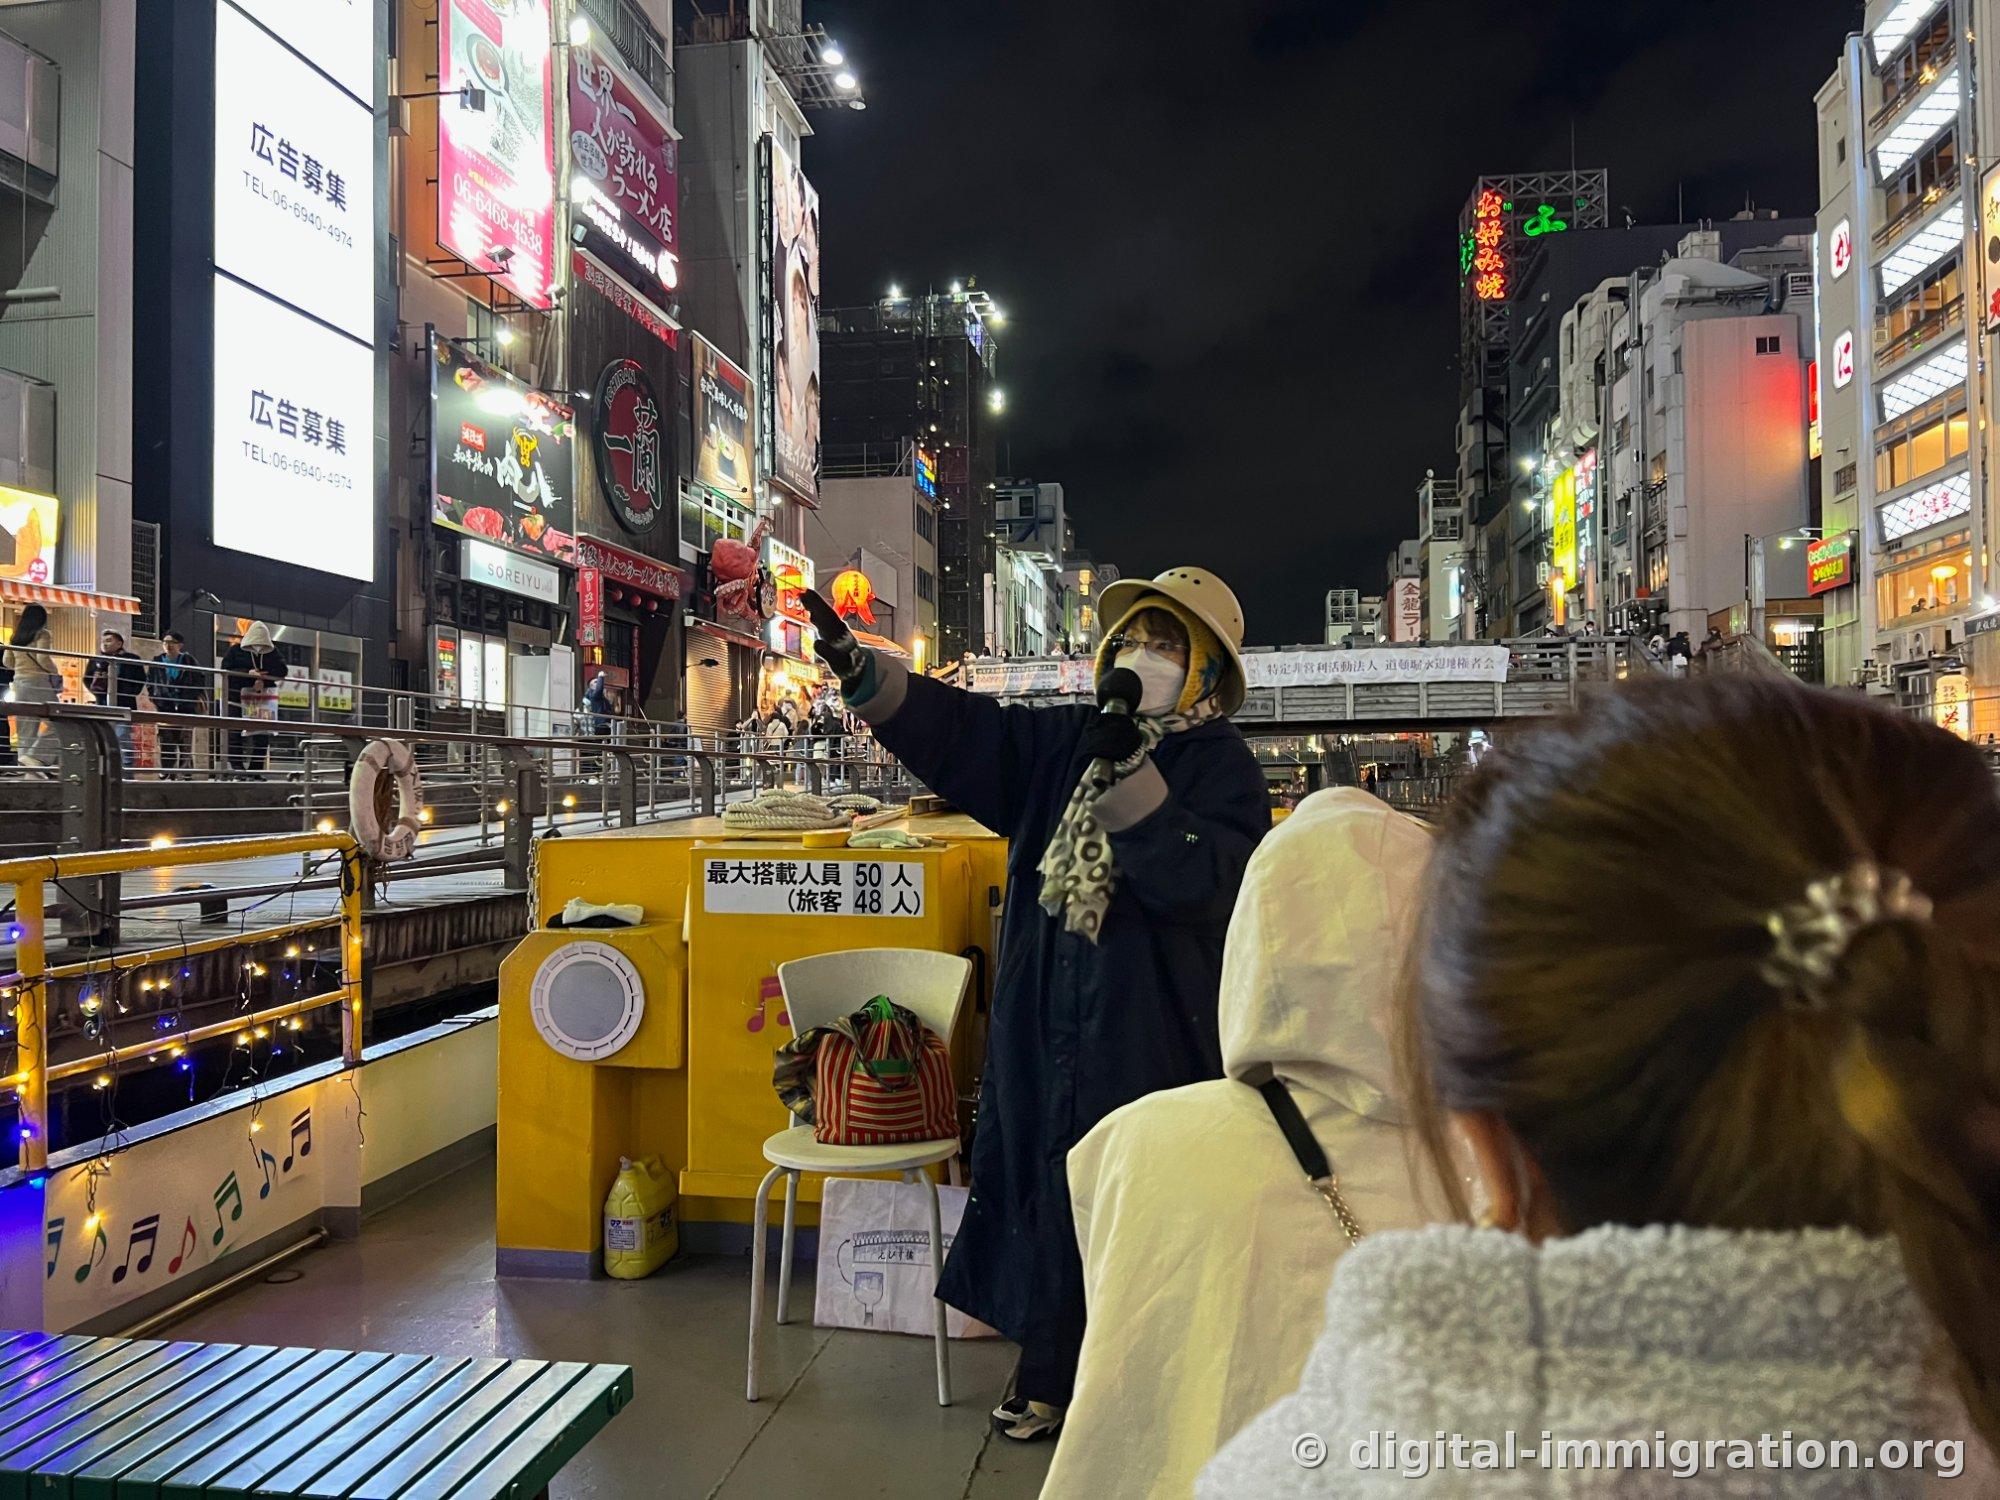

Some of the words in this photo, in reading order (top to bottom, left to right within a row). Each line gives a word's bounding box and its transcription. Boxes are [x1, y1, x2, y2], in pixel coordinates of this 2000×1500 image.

[250, 121, 348, 212] 広告募集
[590, 107, 659, 195] 人が訪れる
[453, 173, 543, 256] 06-6468-4538
[612, 163, 673, 243] ラーメン店
[1474, 190, 1505, 300] お好み焼
[249, 389, 346, 456] 広告募集
[603, 396, 662, 510] 一蘭
[487, 563, 542, 590] SOREIYU
[1401, 582, 1421, 641] 金龍ラー
[1267, 660, 1378, 676] 特定非営利活動法人
[707, 861, 842, 886] 最大搭載人員
[855, 863, 882, 887] 50
[890, 865, 913, 887] 人
[788, 888, 842, 913] (旅客
[854, 890, 882, 914] 48
[890, 891, 921, 916] 人)
